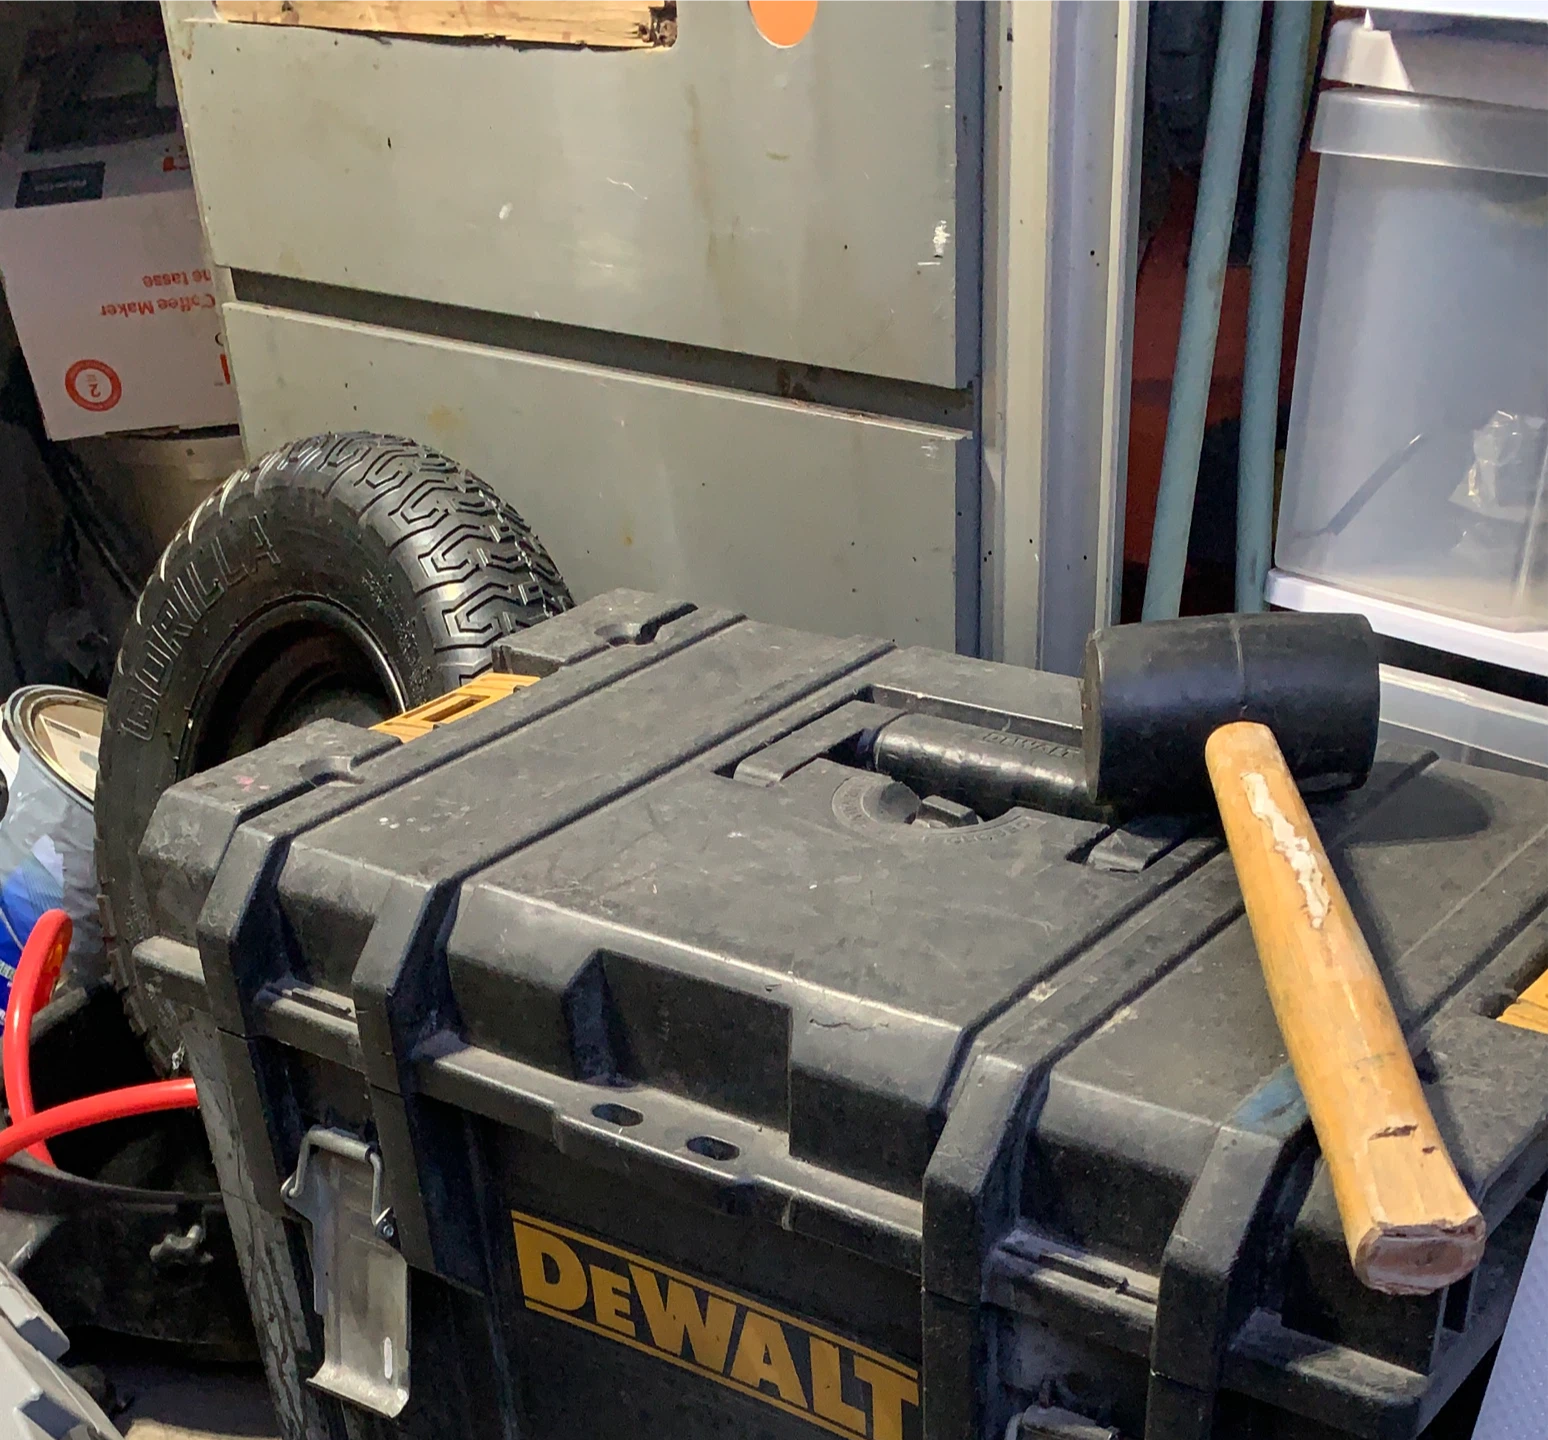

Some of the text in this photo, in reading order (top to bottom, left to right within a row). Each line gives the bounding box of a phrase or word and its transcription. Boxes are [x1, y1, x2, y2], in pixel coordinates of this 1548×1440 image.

[142, 271, 189, 288] tasse
[101, 293, 216, 318] Coffee Maker
[88, 383, 101, 398] 2
[120, 514, 282, 741] GORILLA
